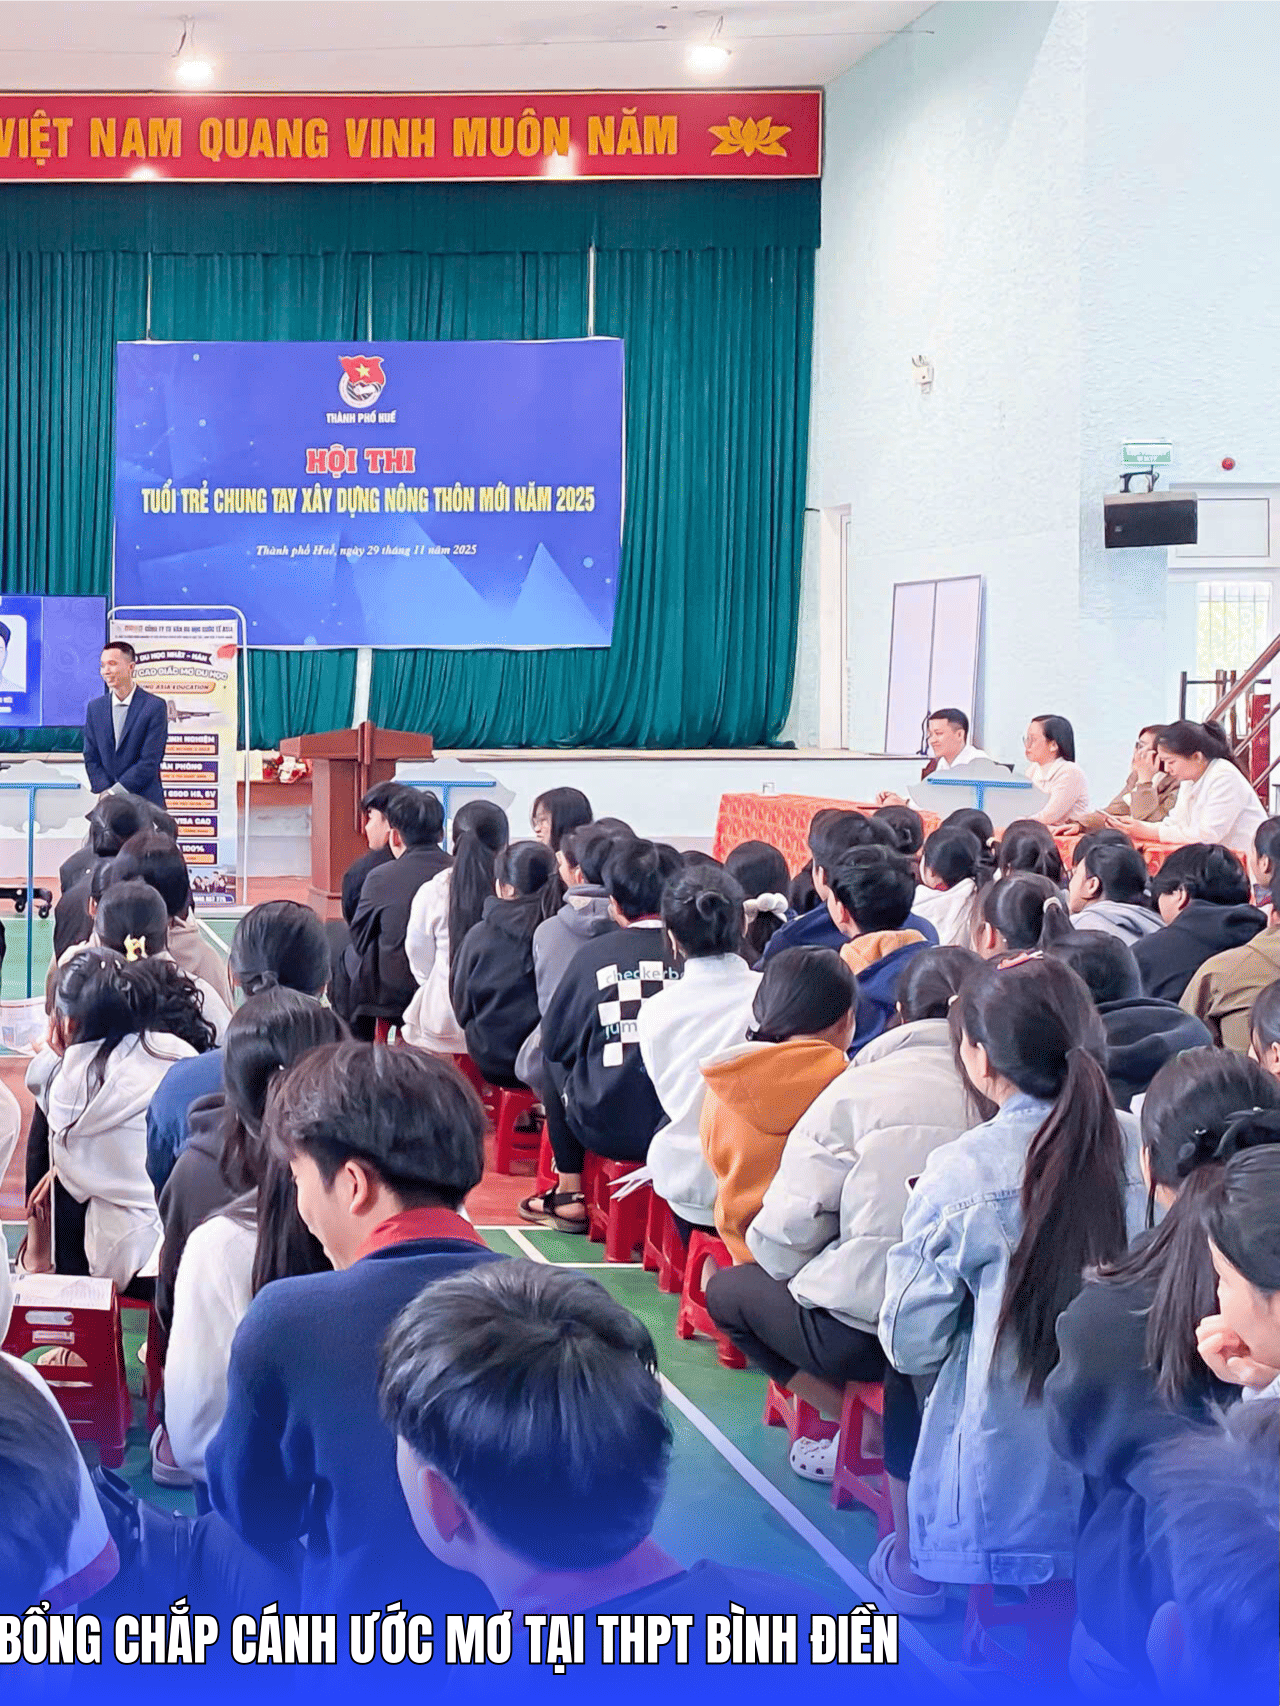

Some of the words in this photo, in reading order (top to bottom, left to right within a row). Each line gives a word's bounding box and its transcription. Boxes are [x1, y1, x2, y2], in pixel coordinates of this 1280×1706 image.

[90, 117, 182, 159] NAM
[199, 117, 329, 161] QUANG
[345, 117, 435, 157] VINH
[454, 108, 570, 158] MUÔN
[588, 107, 678, 156] NĂM
[326, 411, 356, 424] THÀNH
[358, 410, 376, 424] PHỐ
[378, 409, 397, 424] HUẾ
[305, 443, 358, 479] HỘI
[364, 447, 416, 473] THI
[141, 478, 177, 514] TUỔI
[180, 480, 209, 514] TRẺ
[214, 487, 267, 514] CHUNG
[271, 487, 298, 514] TAY
[301, 482, 333, 514] XÂY
[336, 485, 380, 519] DỰNG
[384, 482, 429, 514] NÔNG
[433, 481, 475, 513] THÔN
[479, 481, 510, 512] MỚI
[514, 481, 552, 512] NĂM
[555, 486, 595, 512] 2025
[256, 545, 289, 556] Thành
[290, 544, 311, 558] phố
[340, 545, 365, 558] ngày
[367, 545, 379, 555] 29
[381, 545, 411, 557] tháng
[414, 545, 425, 555] 11
[428, 545, 451, 555] năm
[453, 544, 477, 555] 2025
